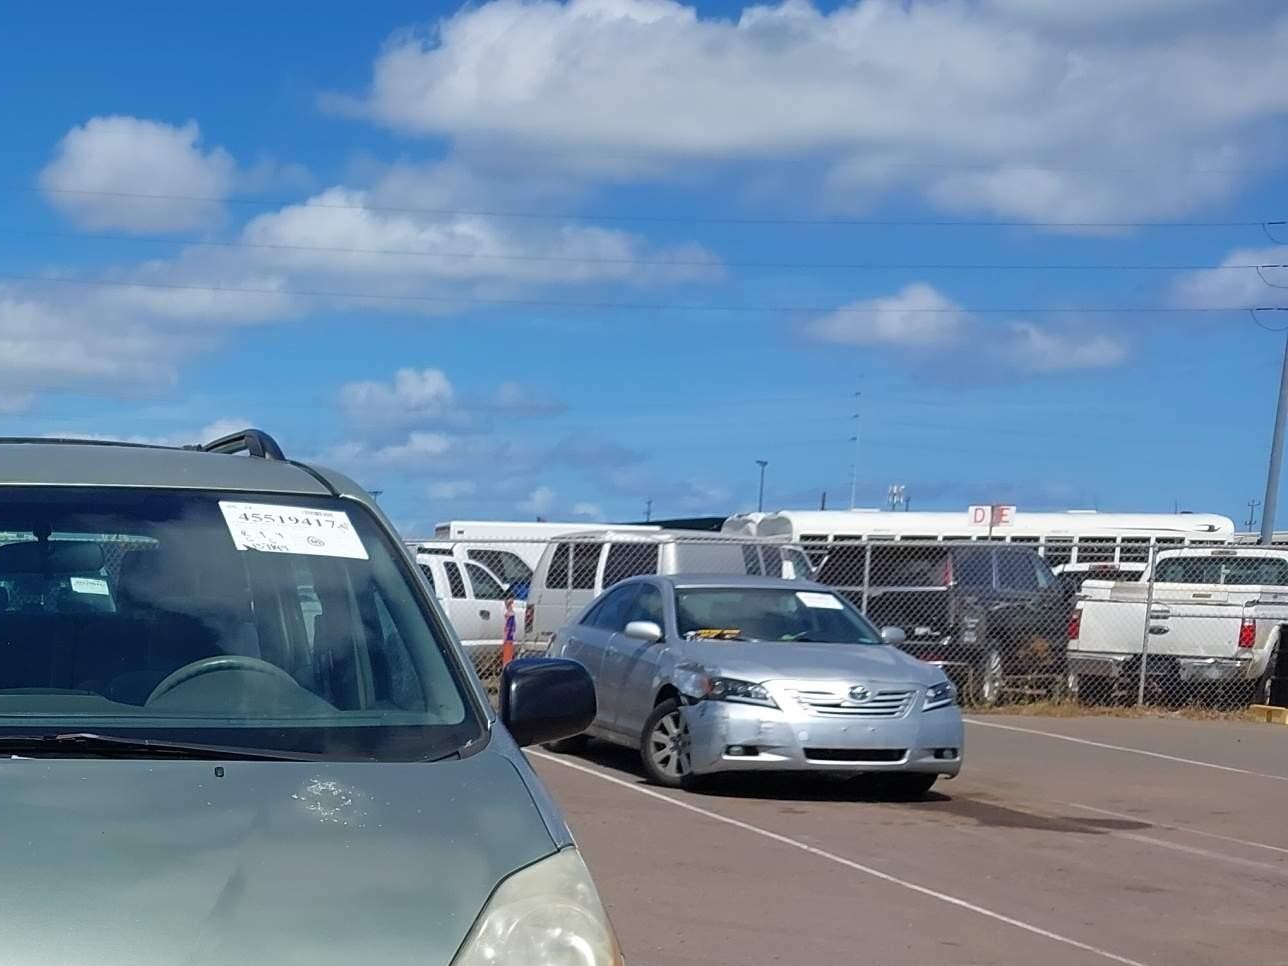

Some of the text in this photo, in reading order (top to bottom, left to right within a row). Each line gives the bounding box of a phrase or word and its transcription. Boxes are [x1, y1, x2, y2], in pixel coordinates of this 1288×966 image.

[238, 512, 335, 528] 45519417
[974, 508, 1010, 523] D E
